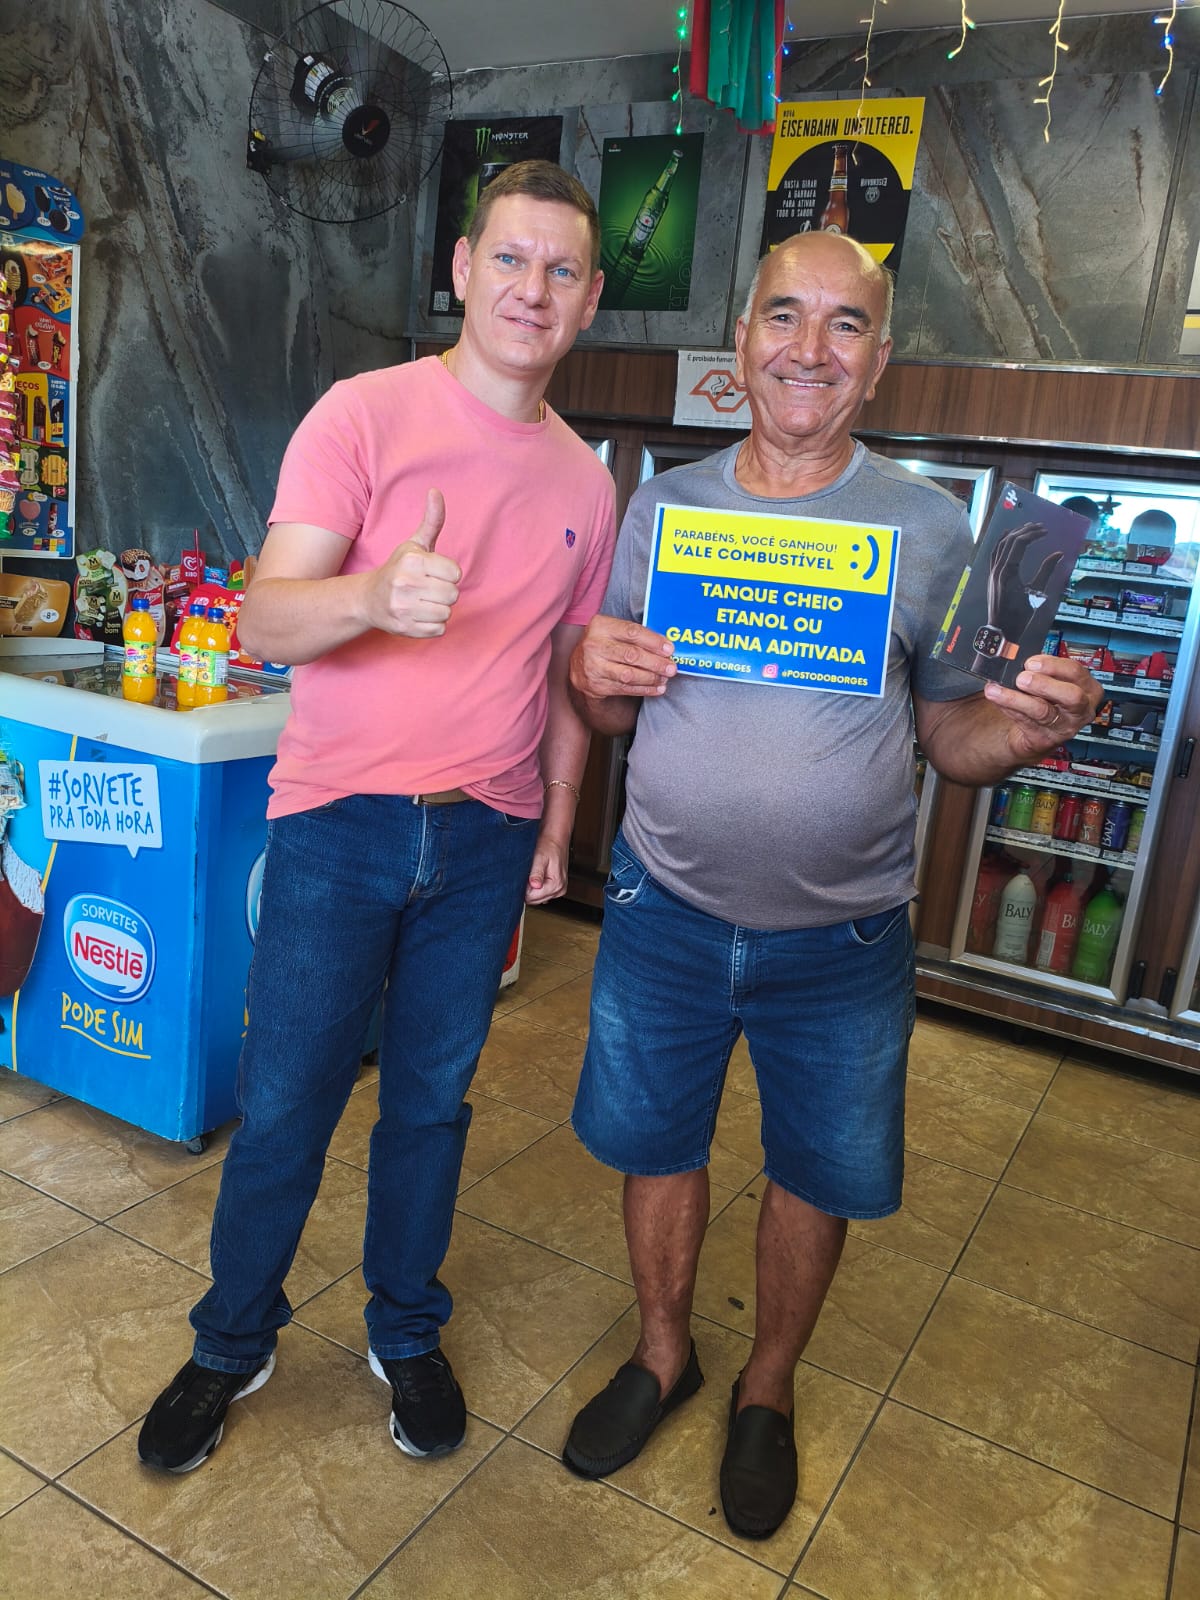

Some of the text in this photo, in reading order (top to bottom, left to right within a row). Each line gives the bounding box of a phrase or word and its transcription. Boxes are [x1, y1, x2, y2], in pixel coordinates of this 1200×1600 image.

[491, 132, 529, 141] MONSTER
[780, 115, 914, 138] EISENBAHN UNFILTERED.
[784, 179, 800, 189] BASTA
[787, 190, 817, 199] A GARRAFA
[776, 209, 790, 218] TODO
[782, 199, 816, 208] PARA ATIVAR
[692, 355, 716, 363] proibido
[15, 381, 40, 391] EÇOS
[674, 529, 838, 553] PARABÉNS, VOCÊ GANHOU!
[673, 543, 835, 571] VALE COMBUSTÍVEL
[701, 582, 843, 612] TANQUE CHEIO
[716, 607, 823, 634] ETANOL OU
[666, 626, 866, 665] GASOLINA ADITIVADA
[698, 659, 713, 668] DO
[714, 660, 752, 673] BORGES
[781, 669, 868, 686] @POSTODOBORGES
[48, 769, 144, 807] #SORVETE
[1035, 799, 1055, 810] BALY
[49, 804, 154, 835] PRA TODA HORA
[1102, 819, 1116, 847] BALY
[81, 903, 139, 934] SORVETES
[1005, 903, 1034, 920] BALY
[1062, 914, 1077, 929] BA
[74, 932, 144, 979] Nestlé
[61, 992, 144, 1051] PODE SIM
